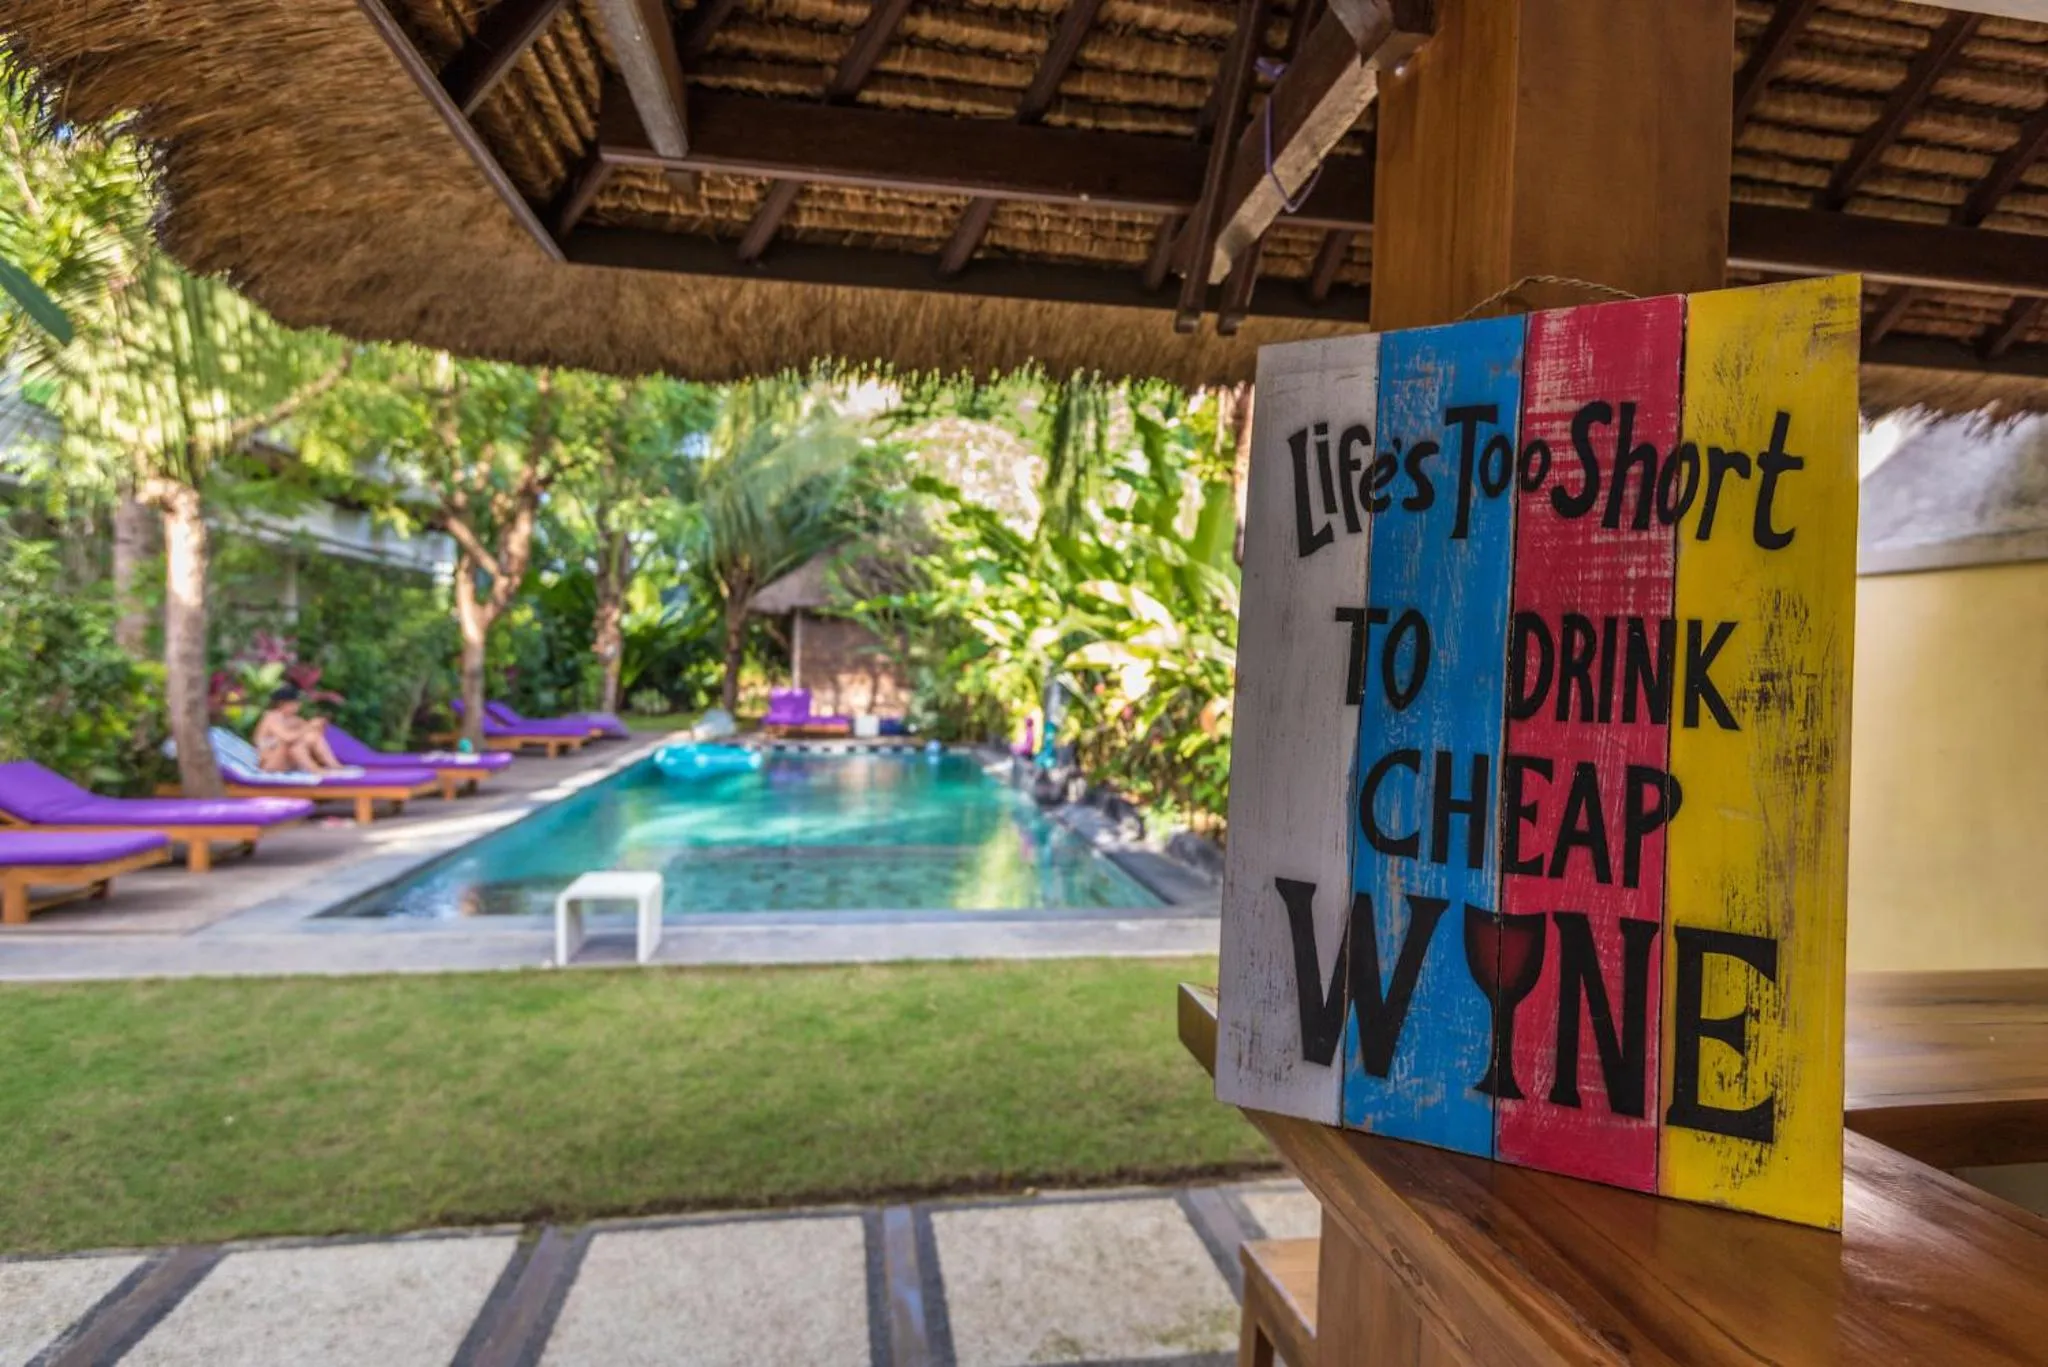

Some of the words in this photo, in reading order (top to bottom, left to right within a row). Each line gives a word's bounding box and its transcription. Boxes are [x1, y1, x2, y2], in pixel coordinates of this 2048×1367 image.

[1287, 421, 1440, 558] Life's
[1444, 403, 1551, 540] Too
[1552, 400, 1805, 551] Short
[1335, 606, 1432, 711] TO
[1507, 611, 1742, 732] DRINK
[1358, 749, 1683, 890] CHEAP
[1274, 876, 1779, 1144] WINE
